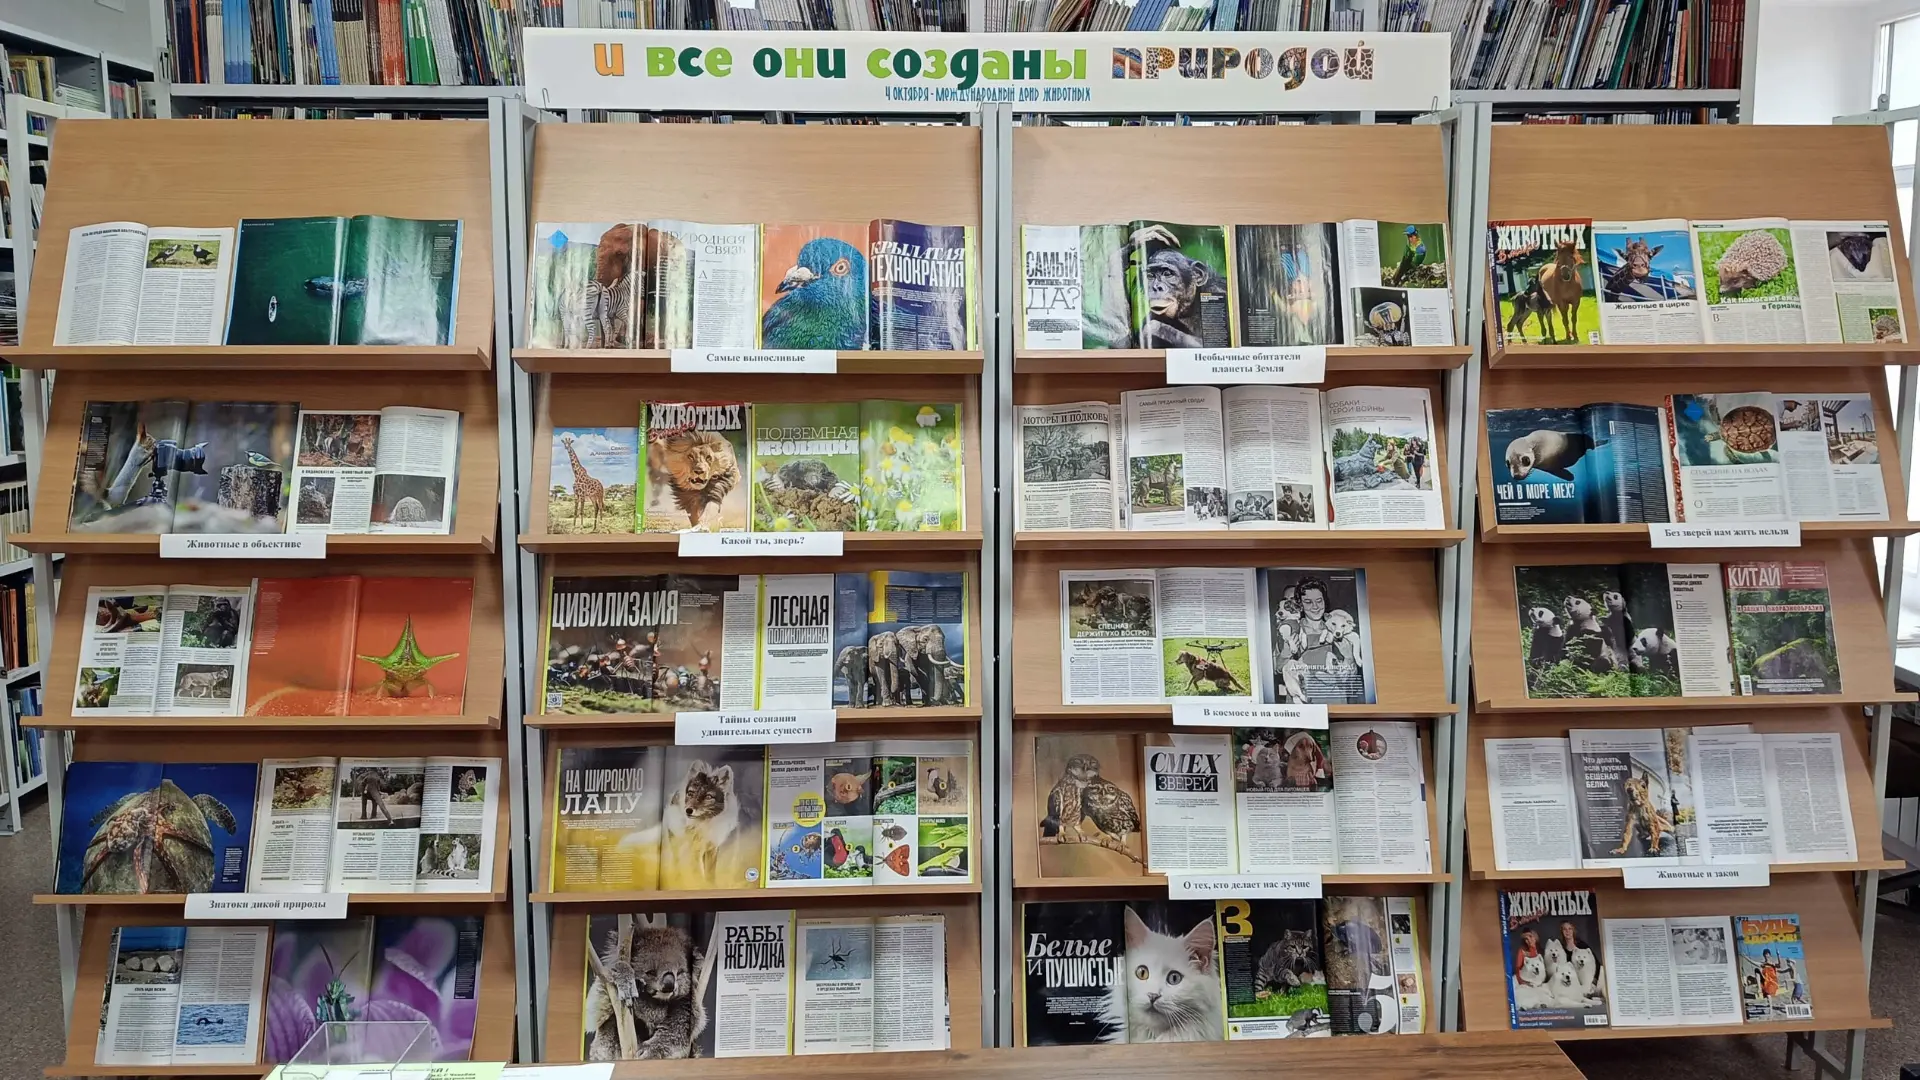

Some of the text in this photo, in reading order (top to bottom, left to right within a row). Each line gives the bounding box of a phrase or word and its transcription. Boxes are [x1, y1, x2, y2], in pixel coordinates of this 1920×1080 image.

[752, 47, 847, 79] они
[866, 48, 1087, 91] созданы
[1111, 40, 1376, 91] природой
[1496, 223, 1586, 250] ЖИВОТНЫХ
[1026, 247, 1078, 278] САМЫЙ
[871, 254, 965, 288] ТЕХНОКРАТИЯ
[1026, 286, 1081, 316] ДА?
[1615, 302, 1657, 310] Животные
[1665, 301, 1690, 309] цирке
[1720, 296, 1737, 304] Как
[706, 353, 806, 363] Самые выносливые
[1194, 352, 1301, 362] Необычные обитатели
[1211, 364, 1285, 374] планеты Земля
[1329, 400, 1360, 409] СОБАКИ
[1329, 404, 1385, 415] ГЕРОИ ВОЙНЫ
[650, 403, 742, 431] ЖИВОТНЫХ
[1023, 412, 1109, 425] МОТОРЫ И ПОДКОВЫ
[756, 426, 858, 441] ПОДЗЕМНАЯ
[756, 440, 859, 457] ИЗОЛЯЦИЯ
[1496, 483, 1575, 501] ЧЕЙ В МОРЕ МЕХ?
[1664, 528, 1789, 539] Без зверей нам жить нельзя
[187, 539, 239, 549] Животные
[250, 539, 302, 549] объективе
[721, 536, 805, 548] Какой ты, зверь?
[1727, 564, 1781, 587] КИТАЙ
[767, 595, 829, 627] ЛЕСНАЯ
[1098, 622, 1129, 630] СПЕЦНАЗ
[767, 627, 828, 645] ПОЛИКЛИНИКА
[718, 714, 797, 724] Тайны сознания
[1203, 708, 1210, 717] В
[1212, 710, 1250, 718] космосе
[1274, 709, 1301, 718] войне
[701, 727, 812, 738] удивительных существ
[1150, 752, 1222, 774] СМЕХ
[1601, 765, 1628, 773] укусила
[565, 768, 644, 793] НА ШИРОКУЮ
[1158, 774, 1216, 790] ЗВЕРЕЙ
[1586, 781, 1609, 789] БЕЛКА
[560, 793, 641, 816] ЛАПУ
[1657, 870, 1704, 879] Животные
[1713, 870, 1740, 878] закон
[1183, 880, 1311, 891] О тех, кто делает нас лучше
[208, 899, 327, 911] Знатоки дикой природы
[1508, 891, 1593, 916] ЖИВОТНЫХ
[1221, 900, 1254, 937] 3
[724, 925, 785, 943] РАБЫ
[1027, 932, 1112, 958] Белые
[724, 943, 785, 971] ЖЕЛУДКА
[1027, 956, 1125, 988] И ПУШИСТЫЕ
